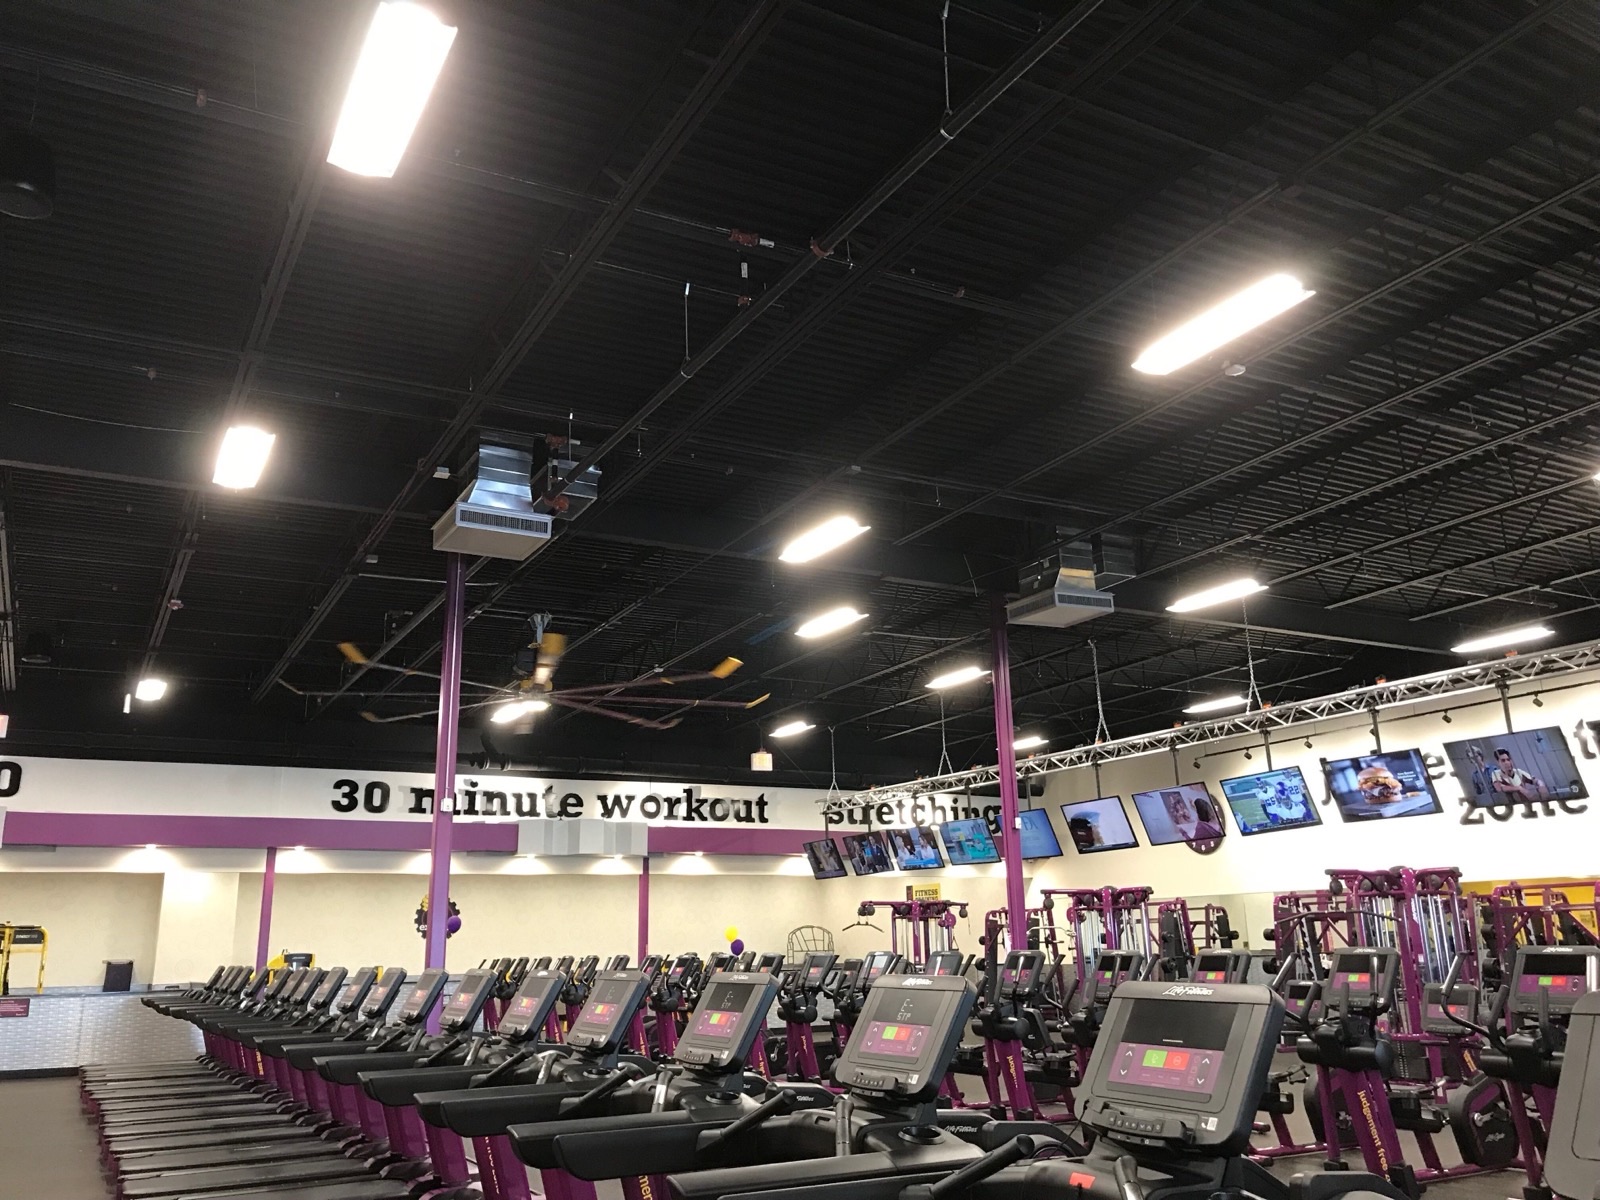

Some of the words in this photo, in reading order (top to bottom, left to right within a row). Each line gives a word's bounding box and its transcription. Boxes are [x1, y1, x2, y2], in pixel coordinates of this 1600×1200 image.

[331, 779, 391, 813] 30
[597, 787, 769, 824] workout
[914, 888, 938, 897] FITNESS
[896, 1012, 912, 1021] STP
[1357, 1089, 1382, 1147] judgement
[1377, 1147, 1389, 1172] free
